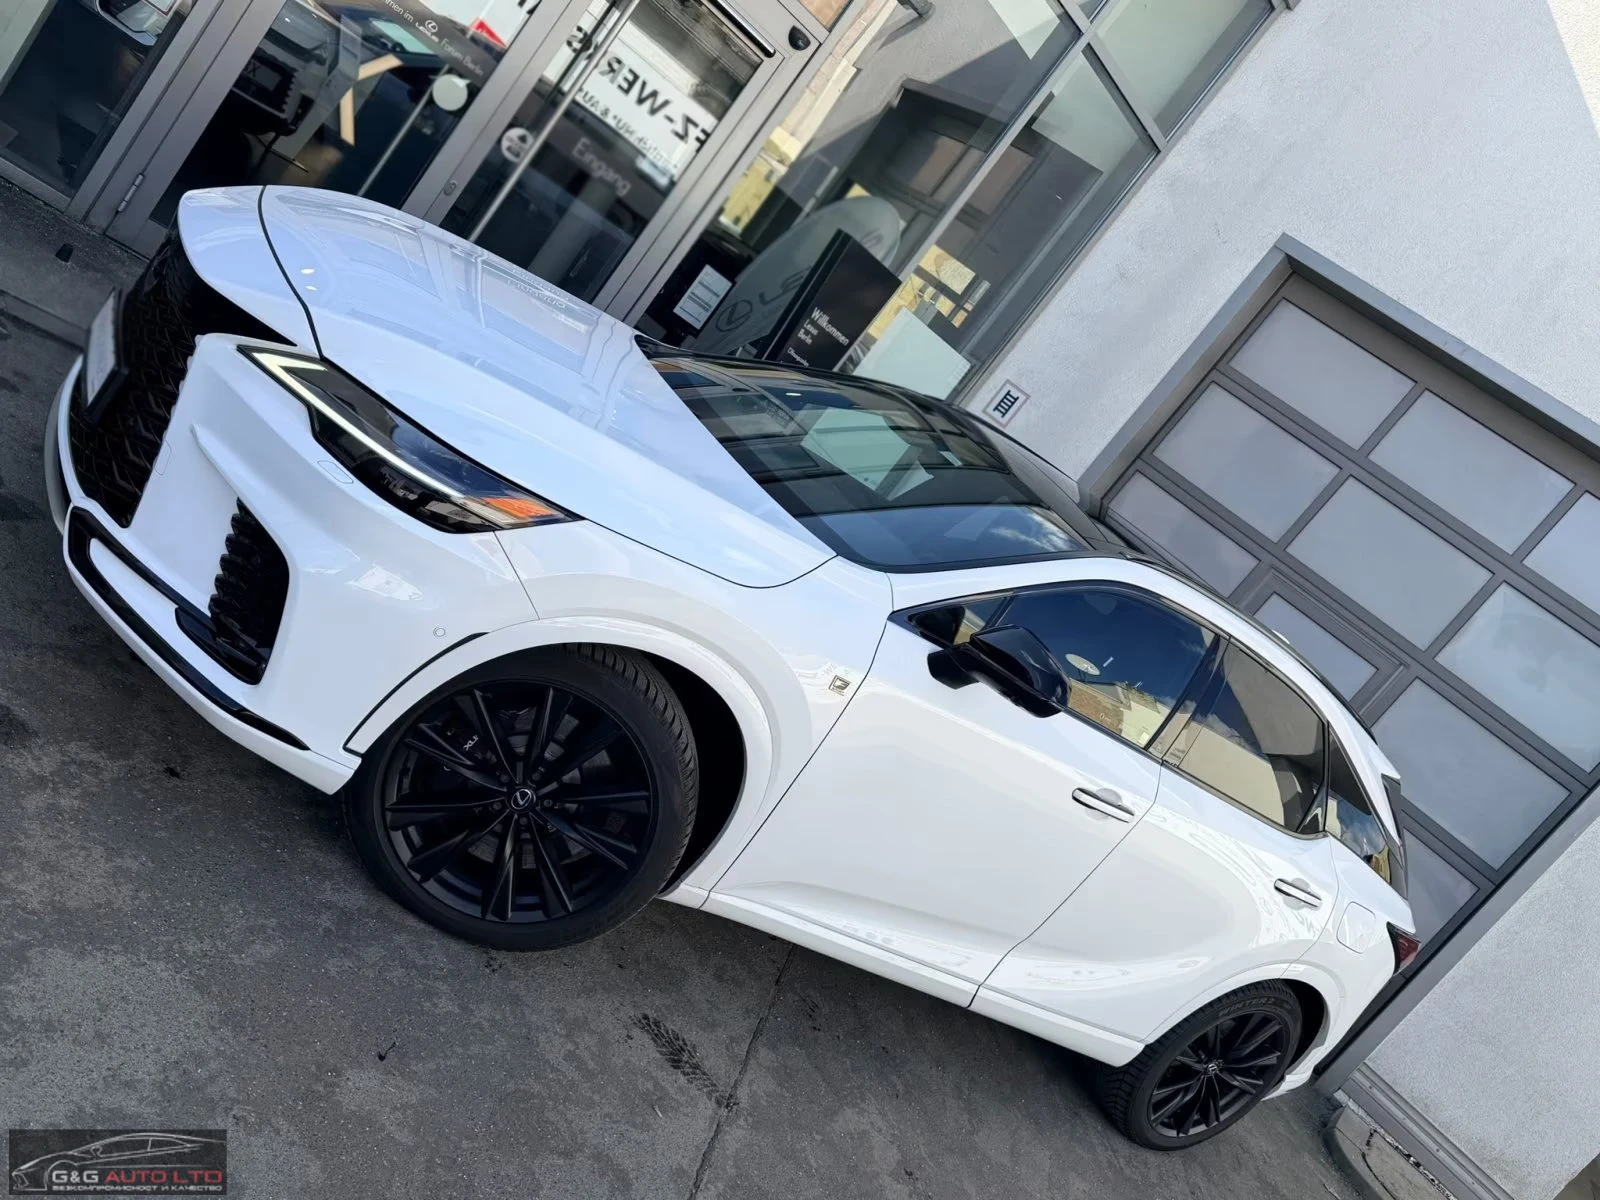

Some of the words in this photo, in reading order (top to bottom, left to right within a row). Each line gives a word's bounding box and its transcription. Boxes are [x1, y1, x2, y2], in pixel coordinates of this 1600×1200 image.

[440, 38, 464, 62] Forum
[463, 55, 485, 77] Berlin
[572, 138, 631, 196] Eingang
[797, 328, 813, 345] Berlin
[803, 319, 819, 336] Lexus
[811, 307, 850, 346] Willkommen
